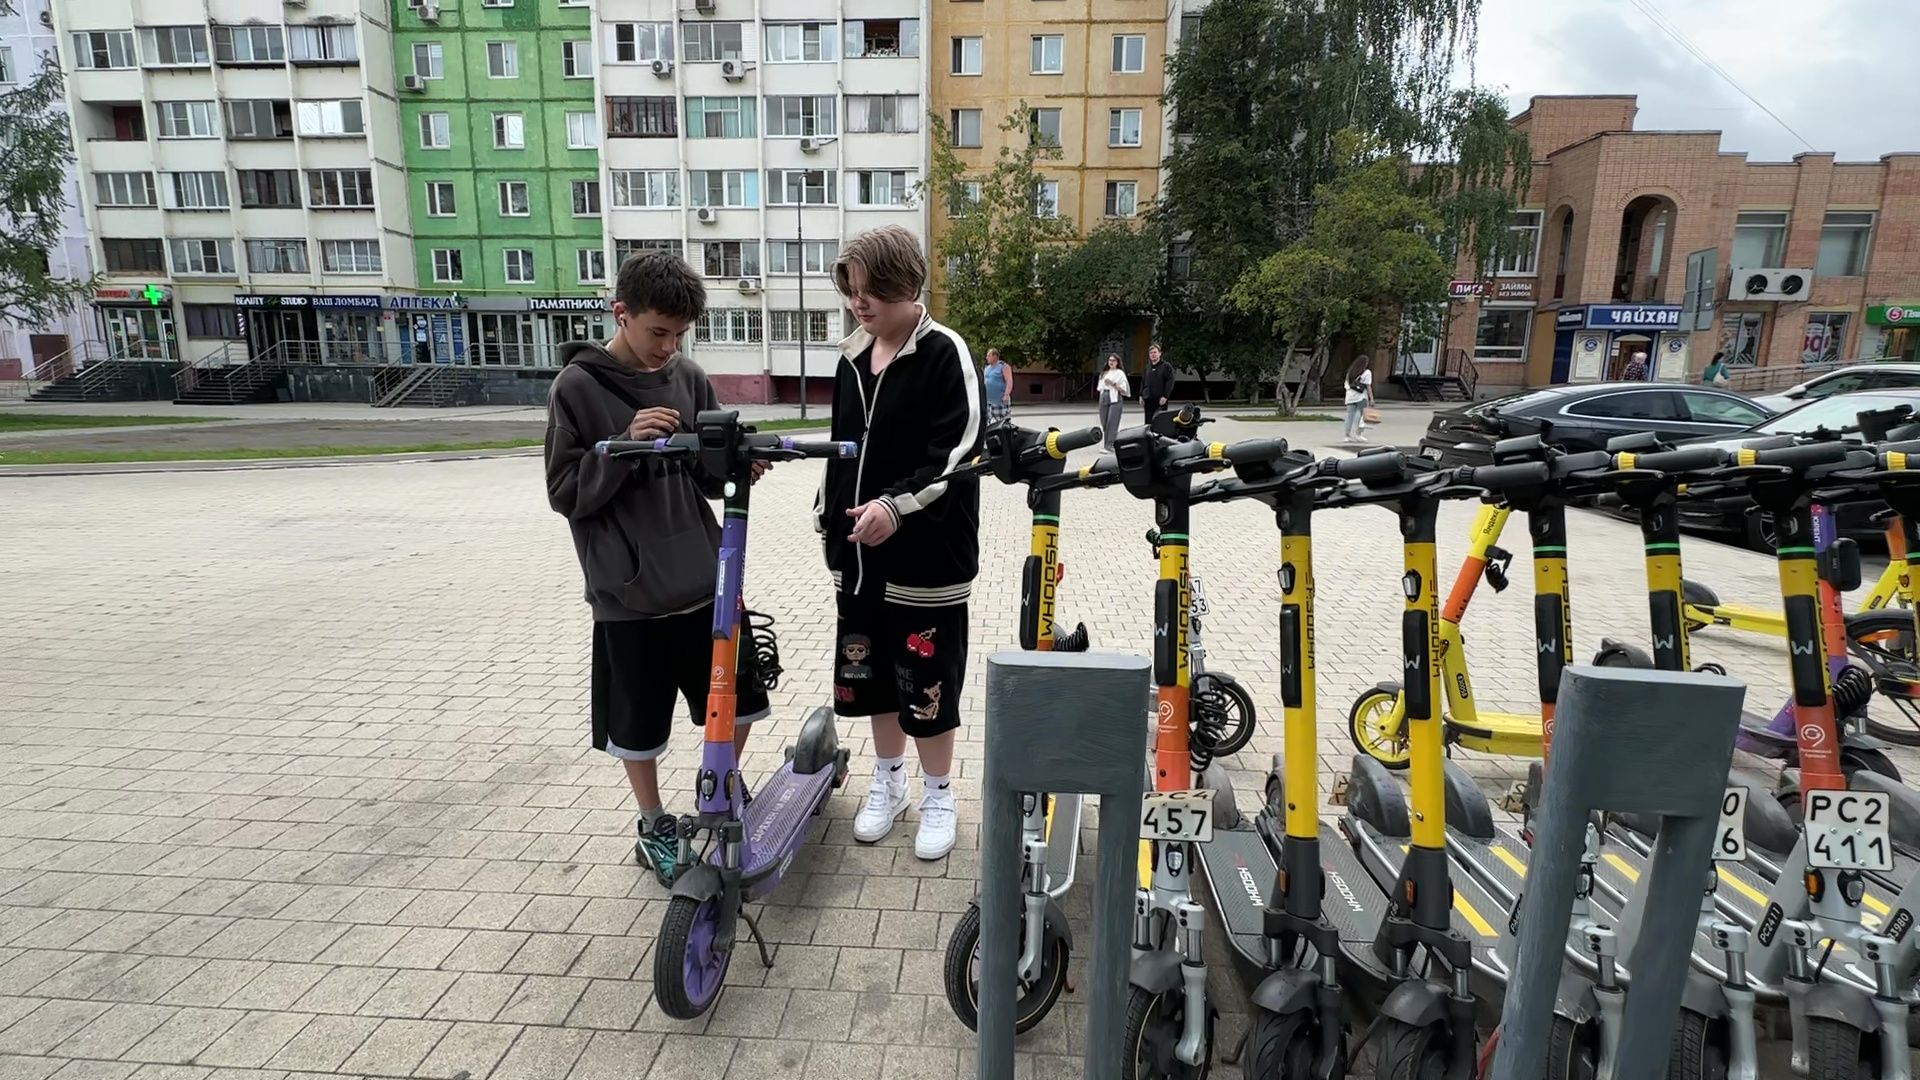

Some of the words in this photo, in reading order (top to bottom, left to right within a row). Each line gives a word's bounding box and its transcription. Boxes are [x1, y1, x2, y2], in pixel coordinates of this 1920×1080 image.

[1500, 282, 1532, 291] ЗАЙМЫ
[235, 296, 264, 306] BEAUTY
[280, 296, 308, 306] STUDIO
[312, 298, 333, 307] ВАШ
[334, 298, 379, 308] ЛОМБАРД
[390, 296, 452, 309] АПТЕКА
[530, 299, 604, 310] ПАМЯТНИКИ
[1611, 306, 1679, 324] ЧАЙХАН
[1041, 532, 1058, 637] WHOOSH
[1192, 598, 1207, 613] 53
[1811, 795, 1882, 825] PC2
[1143, 806, 1207, 836] 457
[1814, 833, 1885, 865] 411
[1237, 867, 1264, 907] WHOOSH
[1327, 871, 1364, 913] WHOOSH
